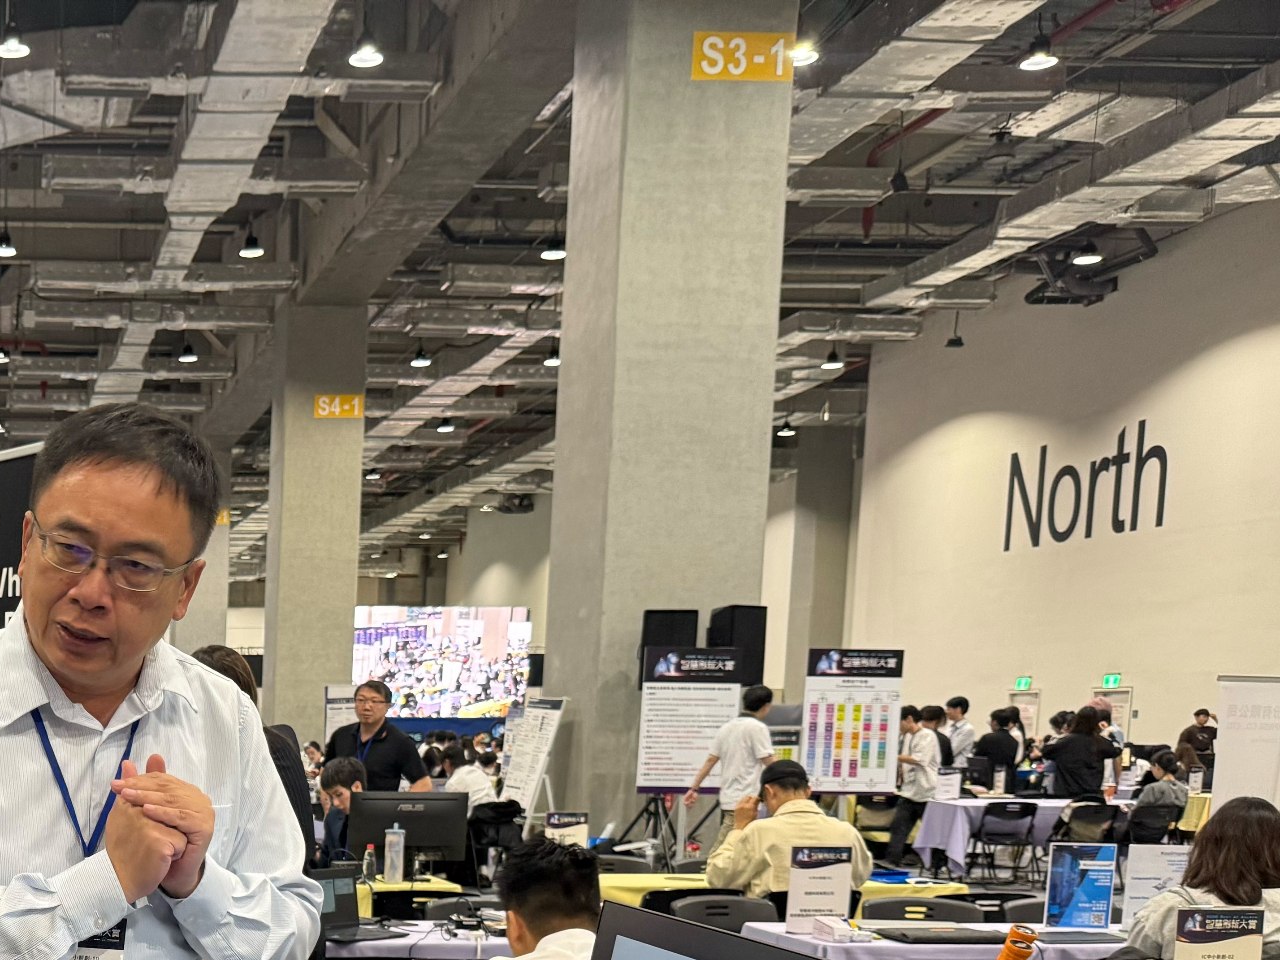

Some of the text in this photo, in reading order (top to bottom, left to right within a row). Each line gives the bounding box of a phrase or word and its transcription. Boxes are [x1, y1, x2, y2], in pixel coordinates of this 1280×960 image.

[701, 36, 785, 76] S3-1
[318, 396, 360, 416] S4-1
[1003, 419, 1168, 552] North
